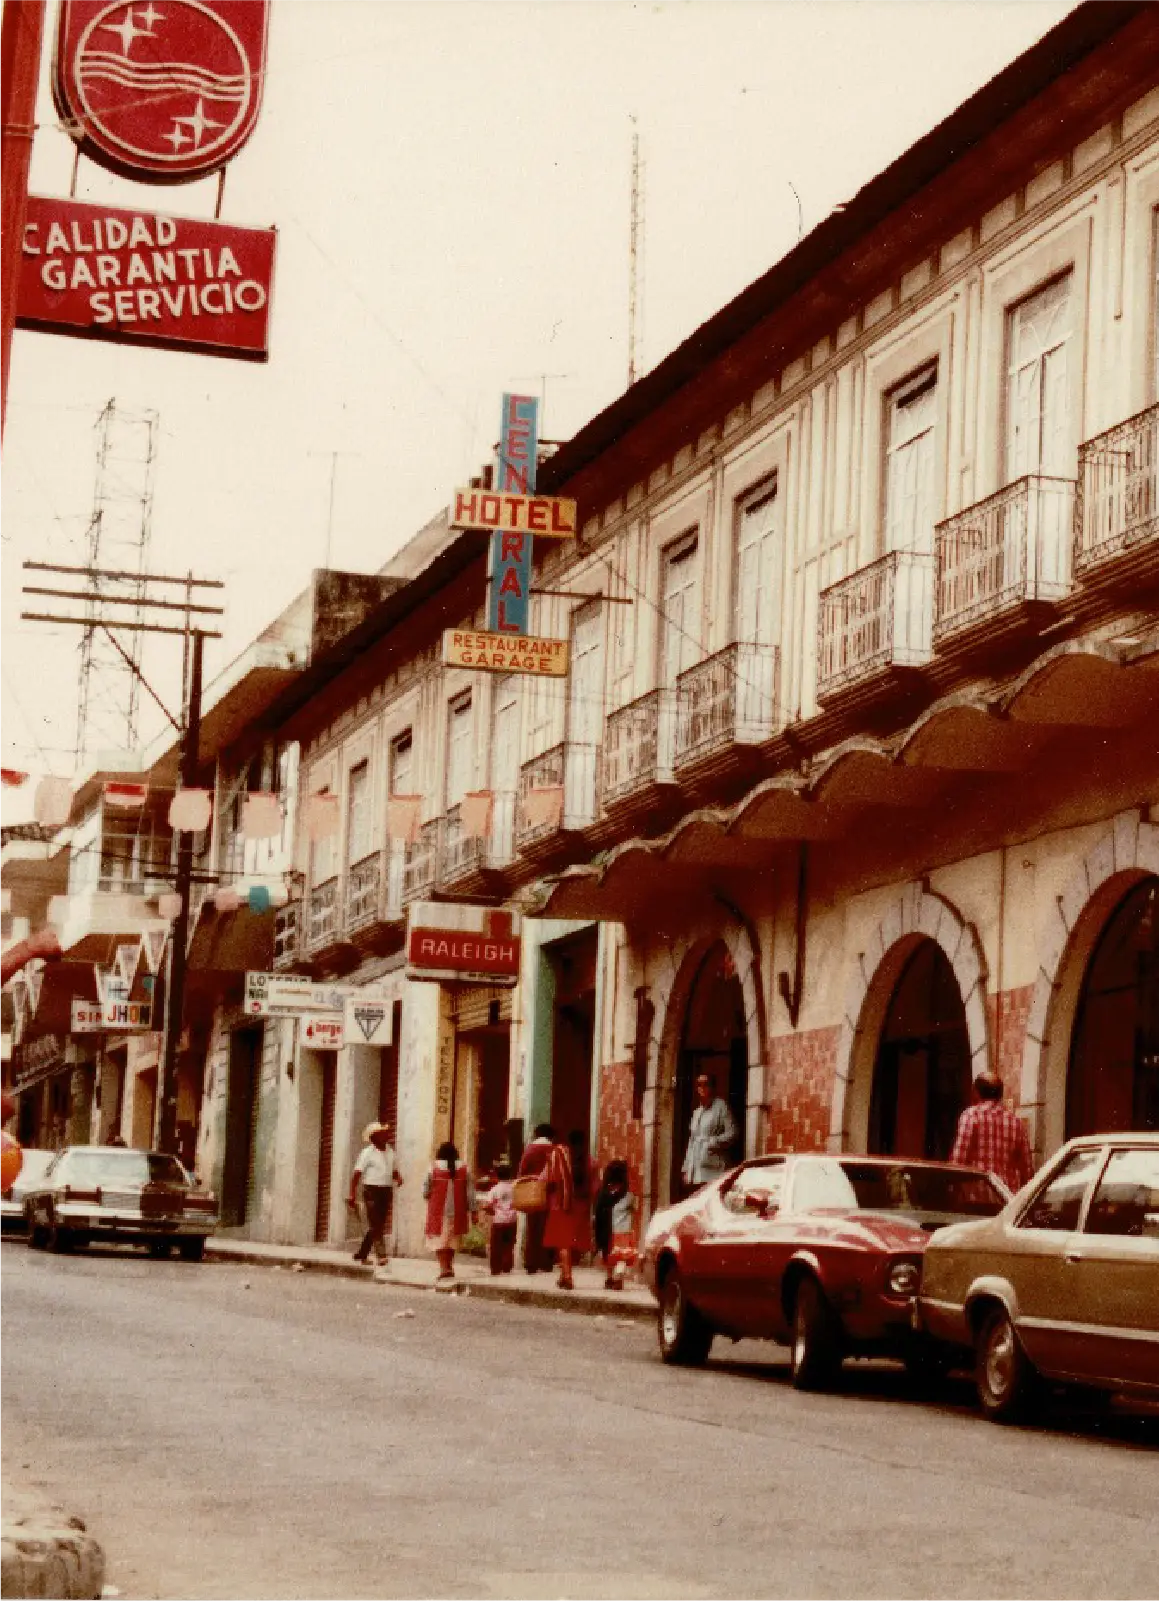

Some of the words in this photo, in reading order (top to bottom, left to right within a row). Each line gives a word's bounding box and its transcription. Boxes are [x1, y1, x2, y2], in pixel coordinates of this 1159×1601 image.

[22, 216, 177, 255] CALIDAD
[41, 247, 242, 290] GARANTIA
[89, 279, 266, 323] SERVICIO
[455, 493, 572, 532] HOTEL
[453, 632, 562, 656] RESTAURANT
[460, 651, 552, 672] GARAGE
[421, 938, 513, 961] RALEIGH
